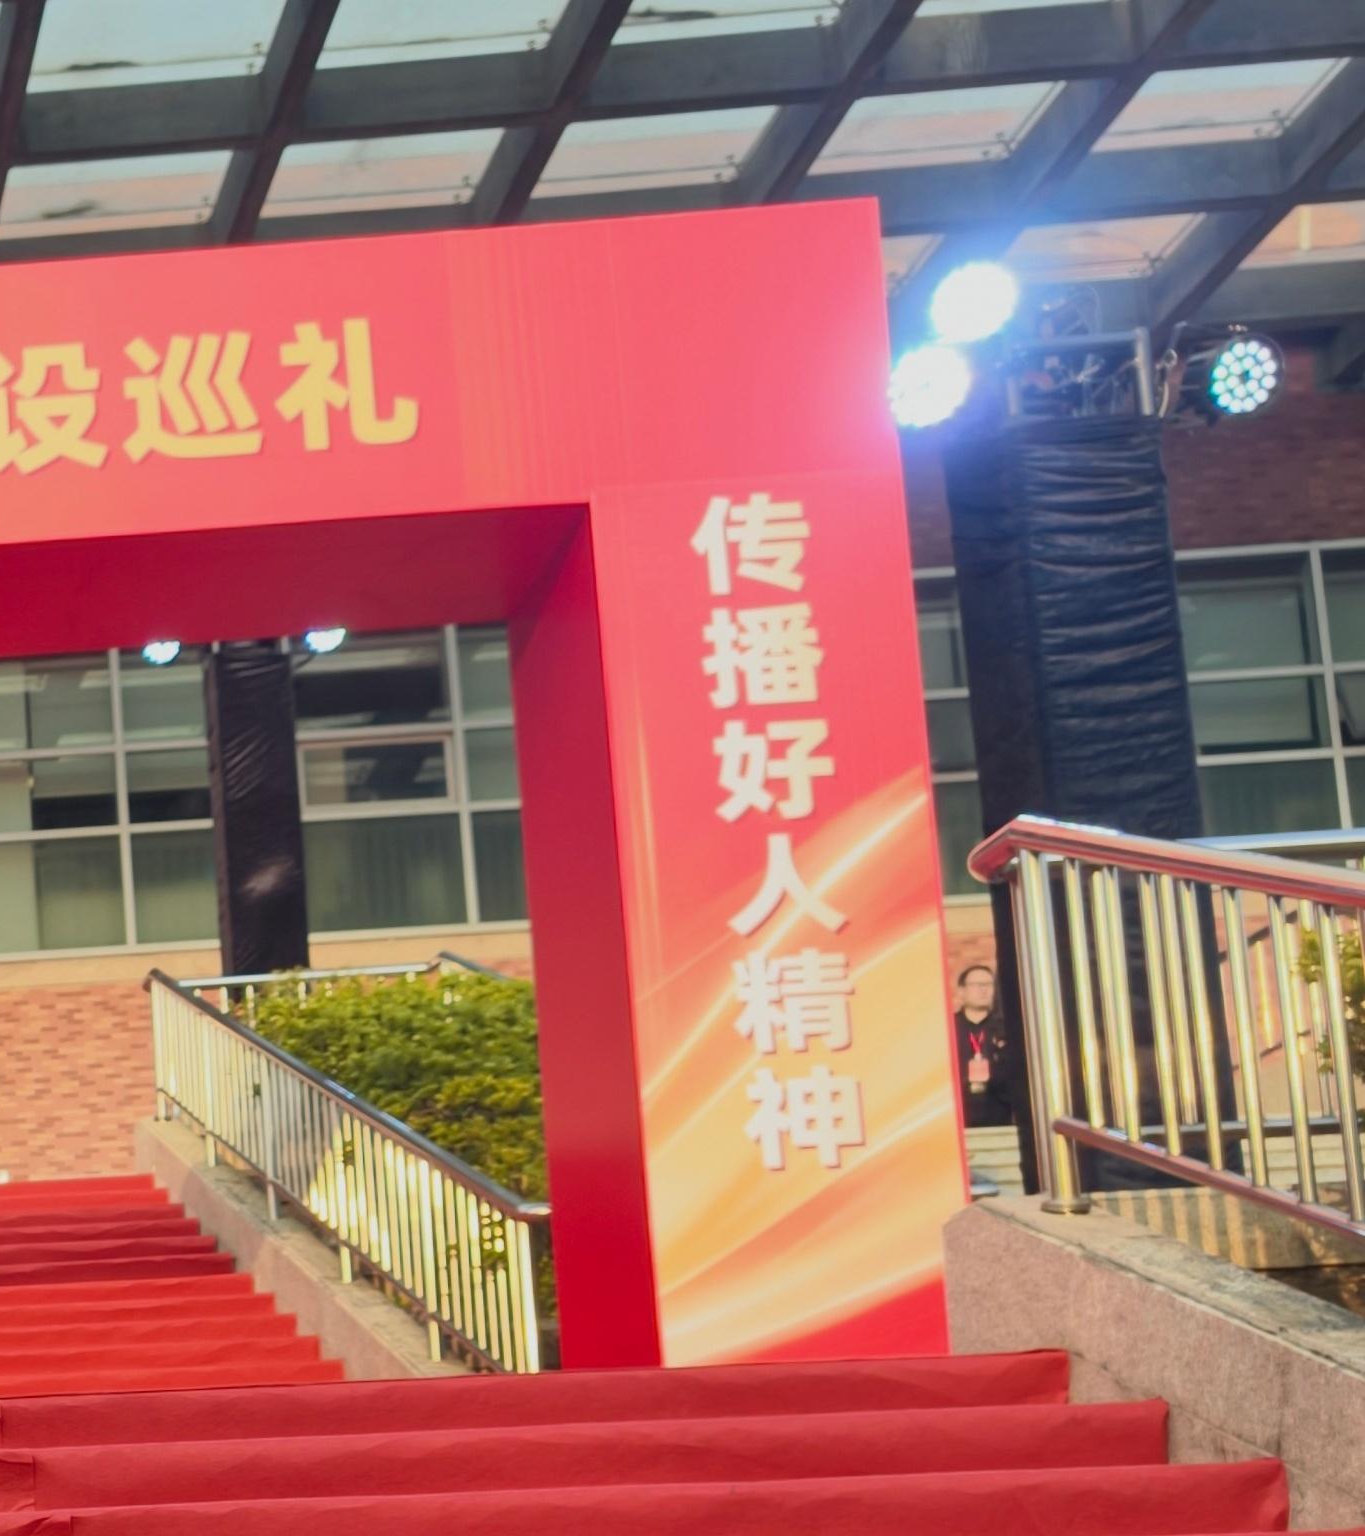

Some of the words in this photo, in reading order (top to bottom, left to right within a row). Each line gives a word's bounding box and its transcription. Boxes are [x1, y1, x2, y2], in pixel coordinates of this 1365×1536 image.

[690, 491, 866, 1171] 传播好人精神
